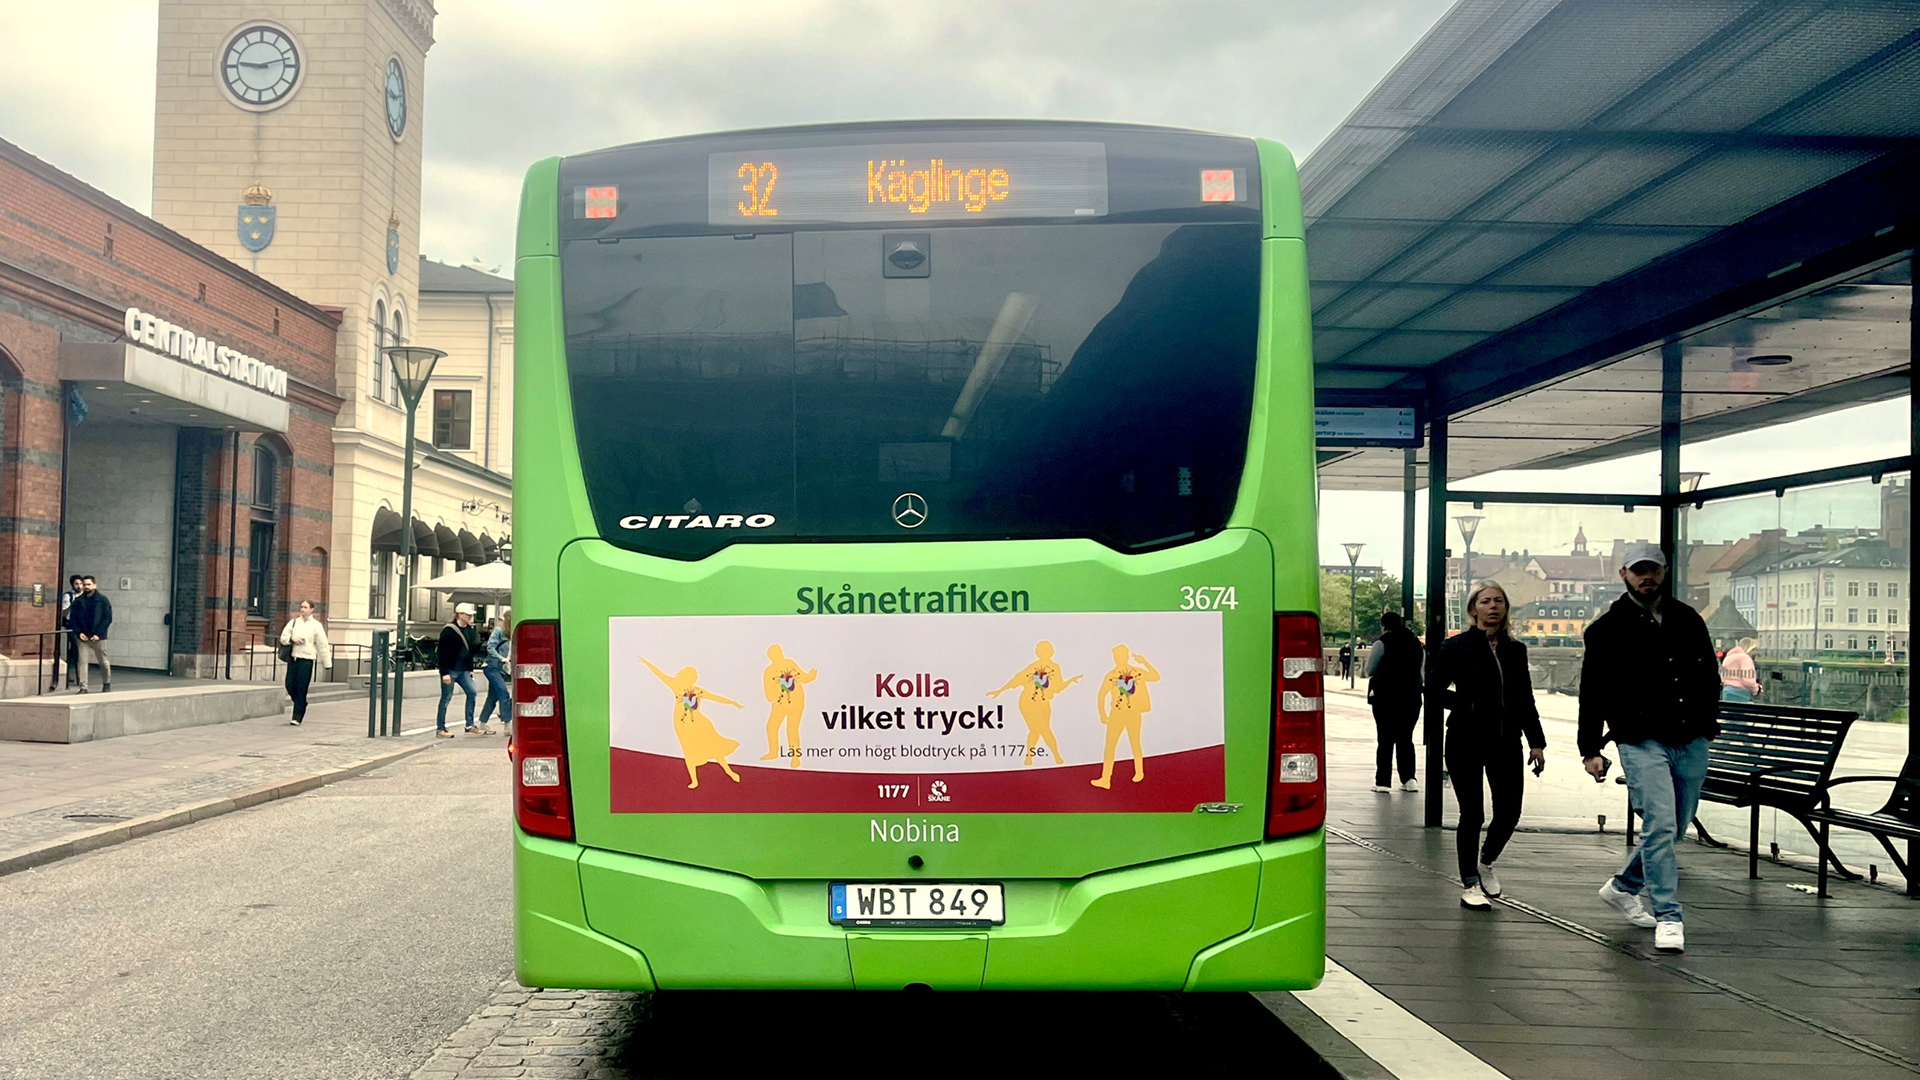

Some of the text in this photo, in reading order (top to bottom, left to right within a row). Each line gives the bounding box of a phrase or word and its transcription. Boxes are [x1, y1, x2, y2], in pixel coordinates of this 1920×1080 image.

[738, 158, 1010, 216] 32 Käglinge
[125, 307, 288, 398] CENTRALSTATION
[619, 514, 776, 530] CITARO
[796, 583, 1030, 613] Skånetrafiken
[1179, 586, 1239, 610] 3674
[875, 673, 950, 698] Kolla
[821, 705, 1004, 736] vilket tryck!
[780, 743, 1049, 760] Läs mer om högt blodtryck på 1177.se.
[877, 784, 910, 799] 1177
[870, 818, 960, 843] Nobina
[836, 905, 843, 914] S
[857, 888, 989, 916] WBT 849
